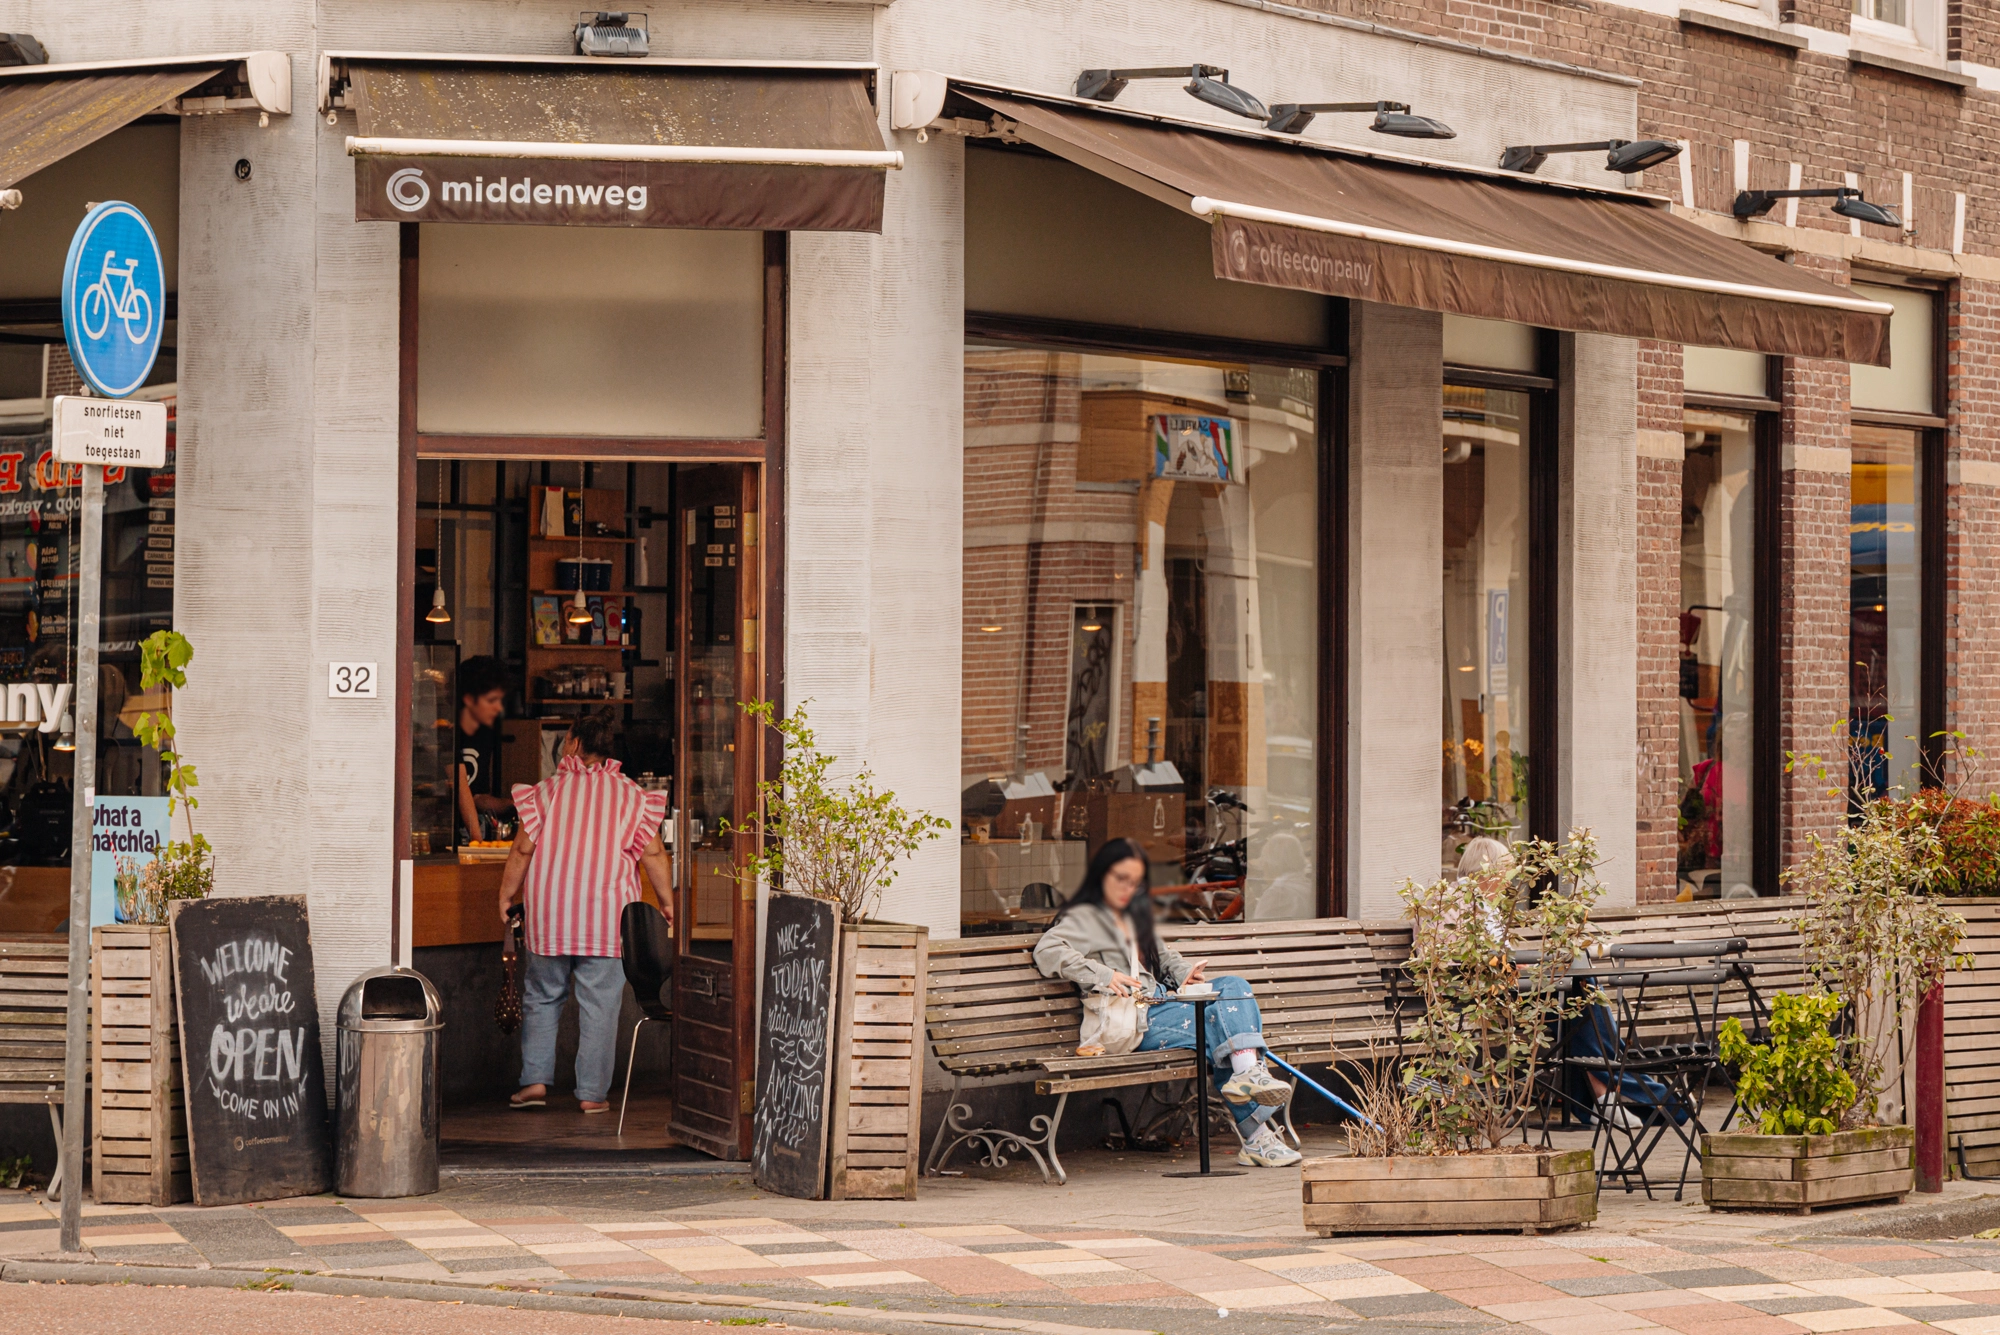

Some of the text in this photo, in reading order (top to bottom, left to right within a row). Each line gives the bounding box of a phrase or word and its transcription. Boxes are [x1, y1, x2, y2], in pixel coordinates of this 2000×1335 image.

[441, 176, 648, 211] middenweg
[1250, 242, 1373, 287] coffeecompany
[84, 405, 142, 420] snorfietsen
[104, 426, 124, 439] niet
[85, 444, 141, 461] toegestaan
[336, 666, 371, 693] 32
[0, 683, 73, 733] ny
[131, 809, 141, 827] a
[776, 923, 801, 956] MAKE
[200, 939, 294, 985] WELCOME
[259, 983, 295, 1014] are
[771, 957, 825, 1006] TODAY
[767, 1001, 827, 1048] ridiculously
[210, 1024, 305, 1081] OPEN
[220, 1089, 299, 1120] COME ON IN
[766, 1059, 820, 1122] AMAZING
